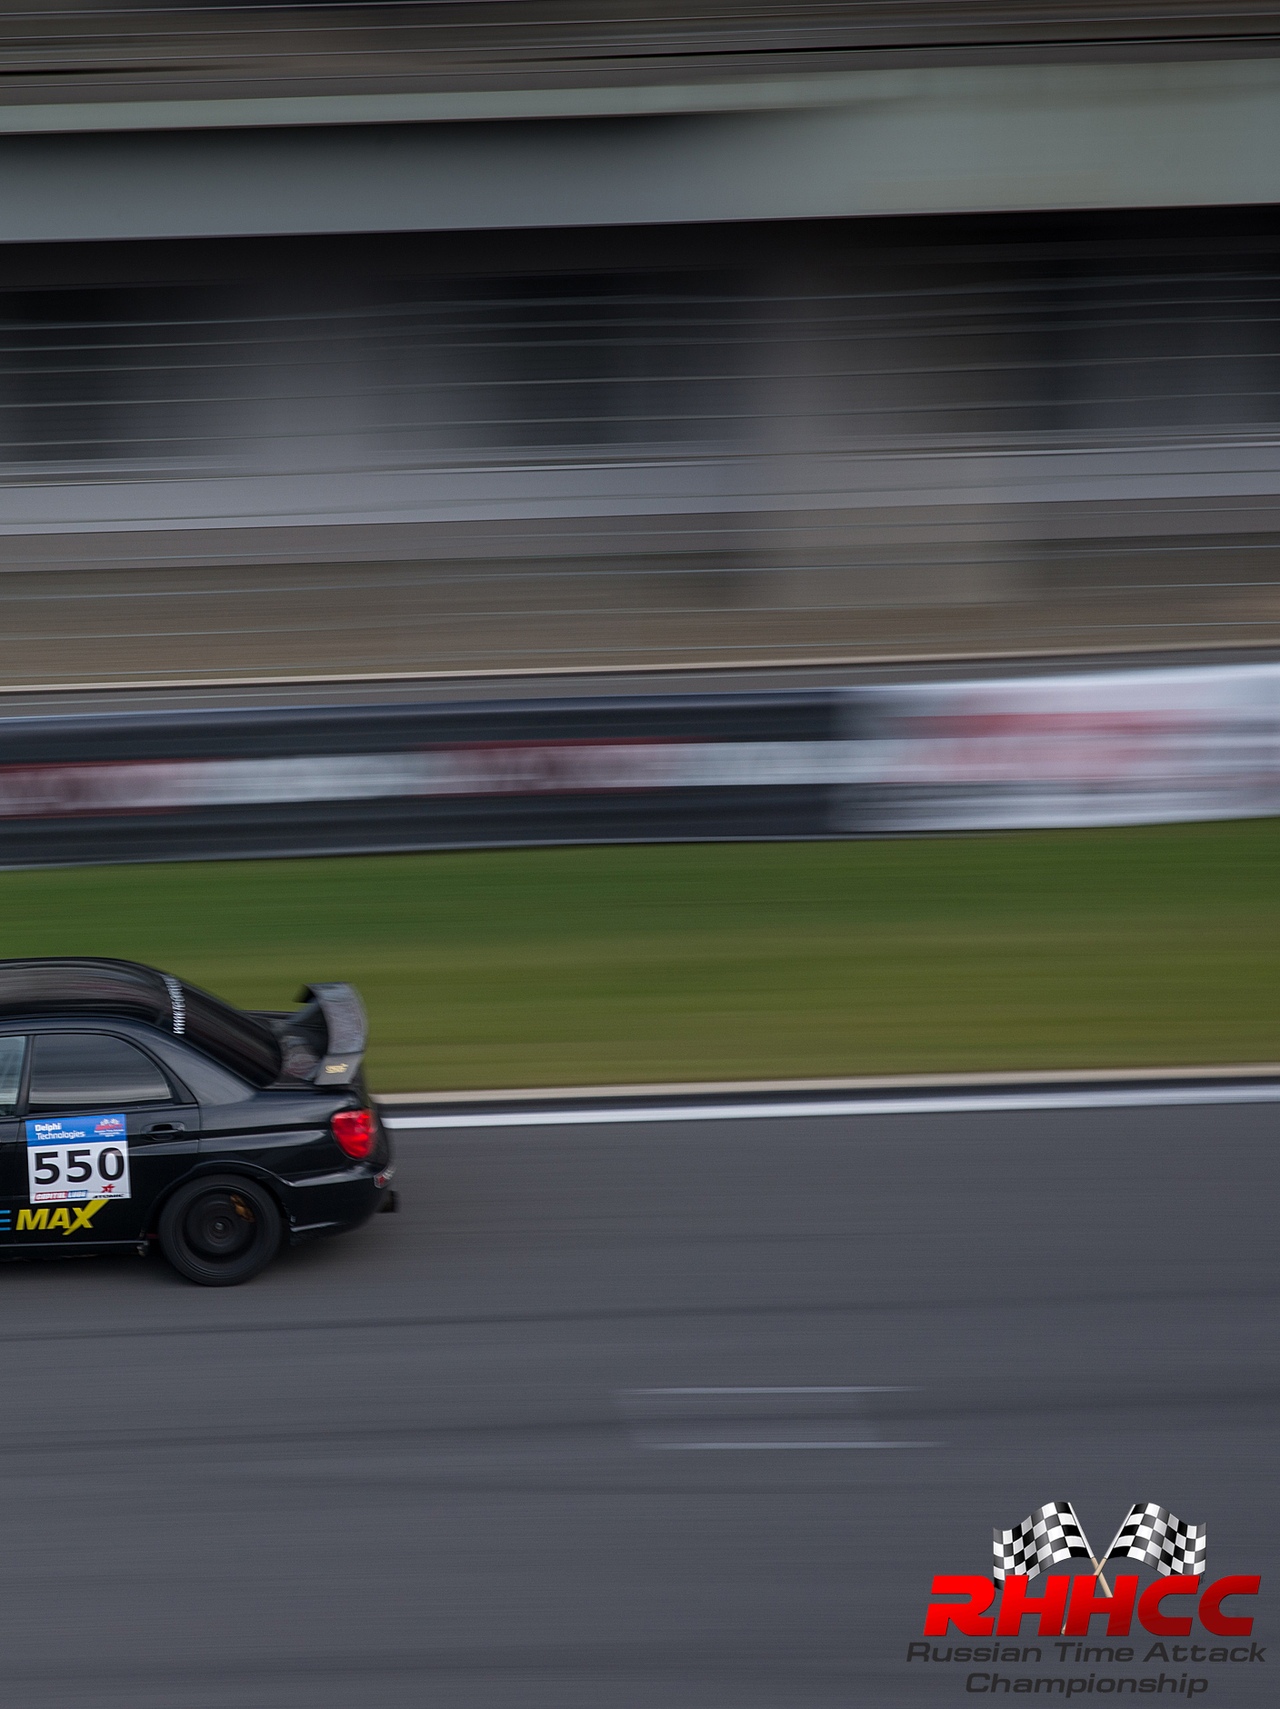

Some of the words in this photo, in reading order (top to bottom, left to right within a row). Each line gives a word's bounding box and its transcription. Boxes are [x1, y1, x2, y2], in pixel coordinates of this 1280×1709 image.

[34, 1122, 62, 1132] Delphi
[36, 1130, 86, 1140] Technologies
[34, 1147, 125, 1185] 550
[15, 1199, 109, 1236] MAX
